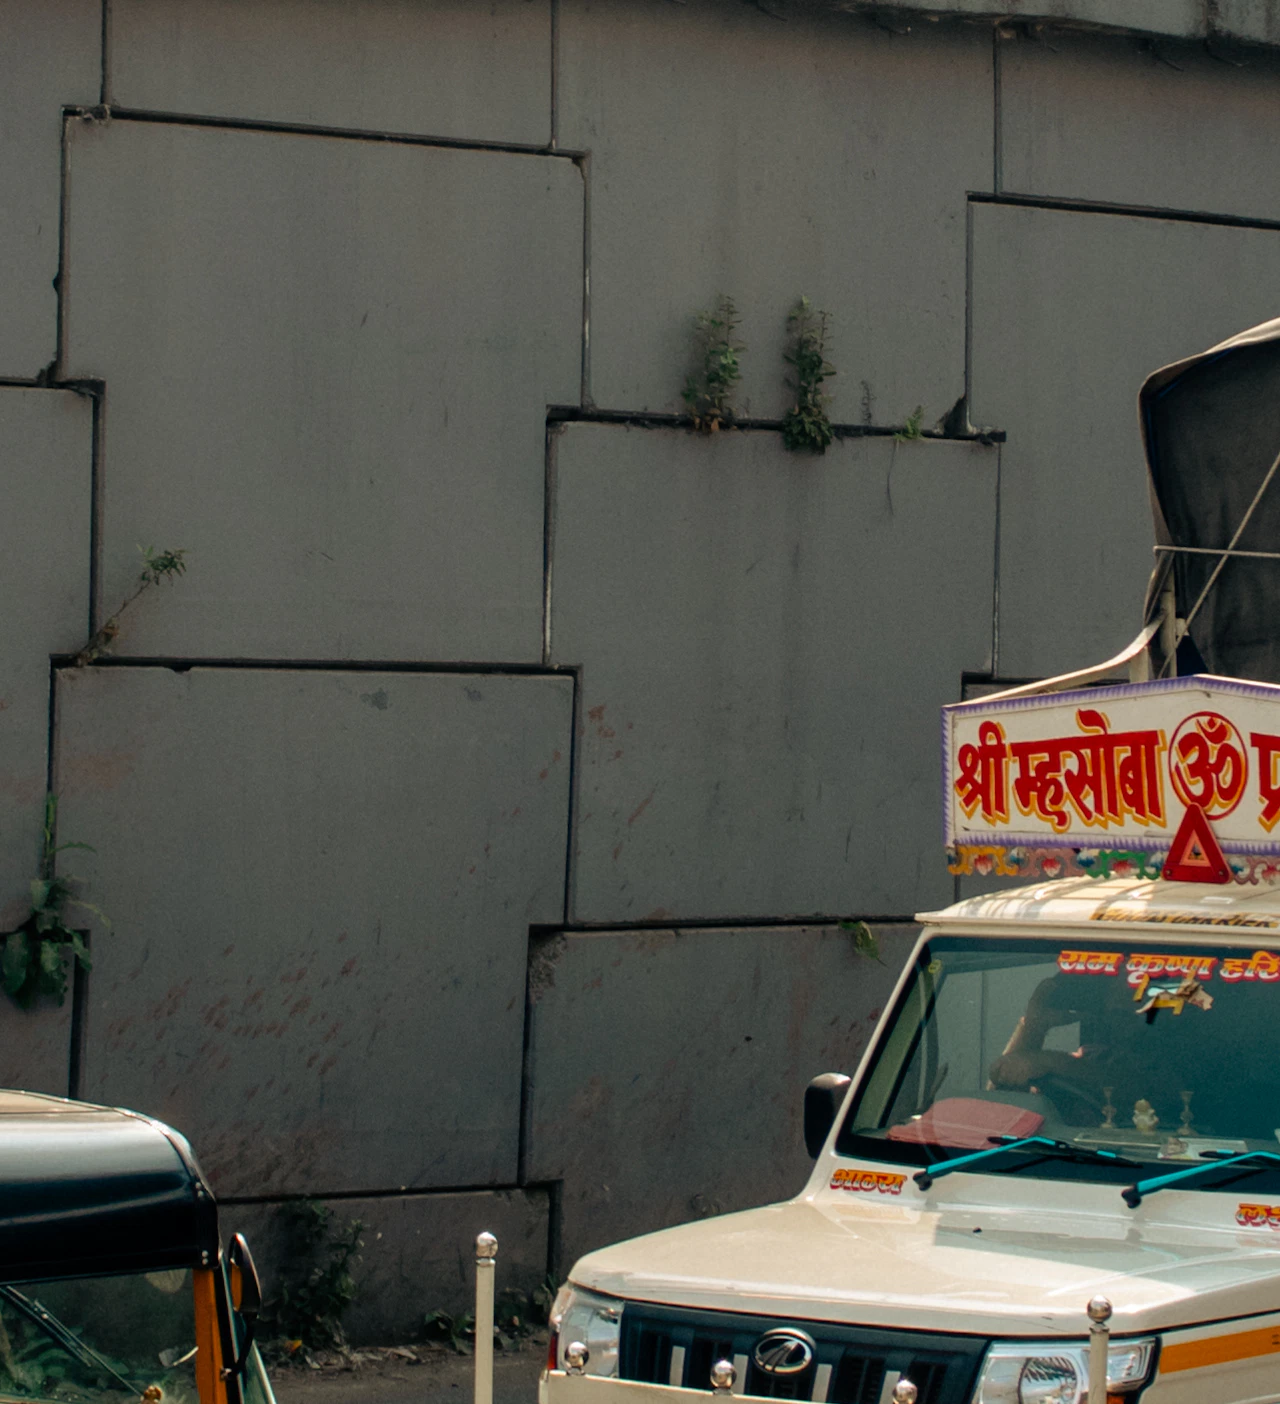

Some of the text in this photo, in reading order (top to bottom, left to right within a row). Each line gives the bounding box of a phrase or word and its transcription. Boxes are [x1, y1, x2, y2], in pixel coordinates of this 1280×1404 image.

[955, 721, 1010, 827] श्री
[1009, 708, 1167, 834] म्हसोबा
[1057, 951, 1124, 976] राम
[1125, 953, 1218, 988] कृष्ण
